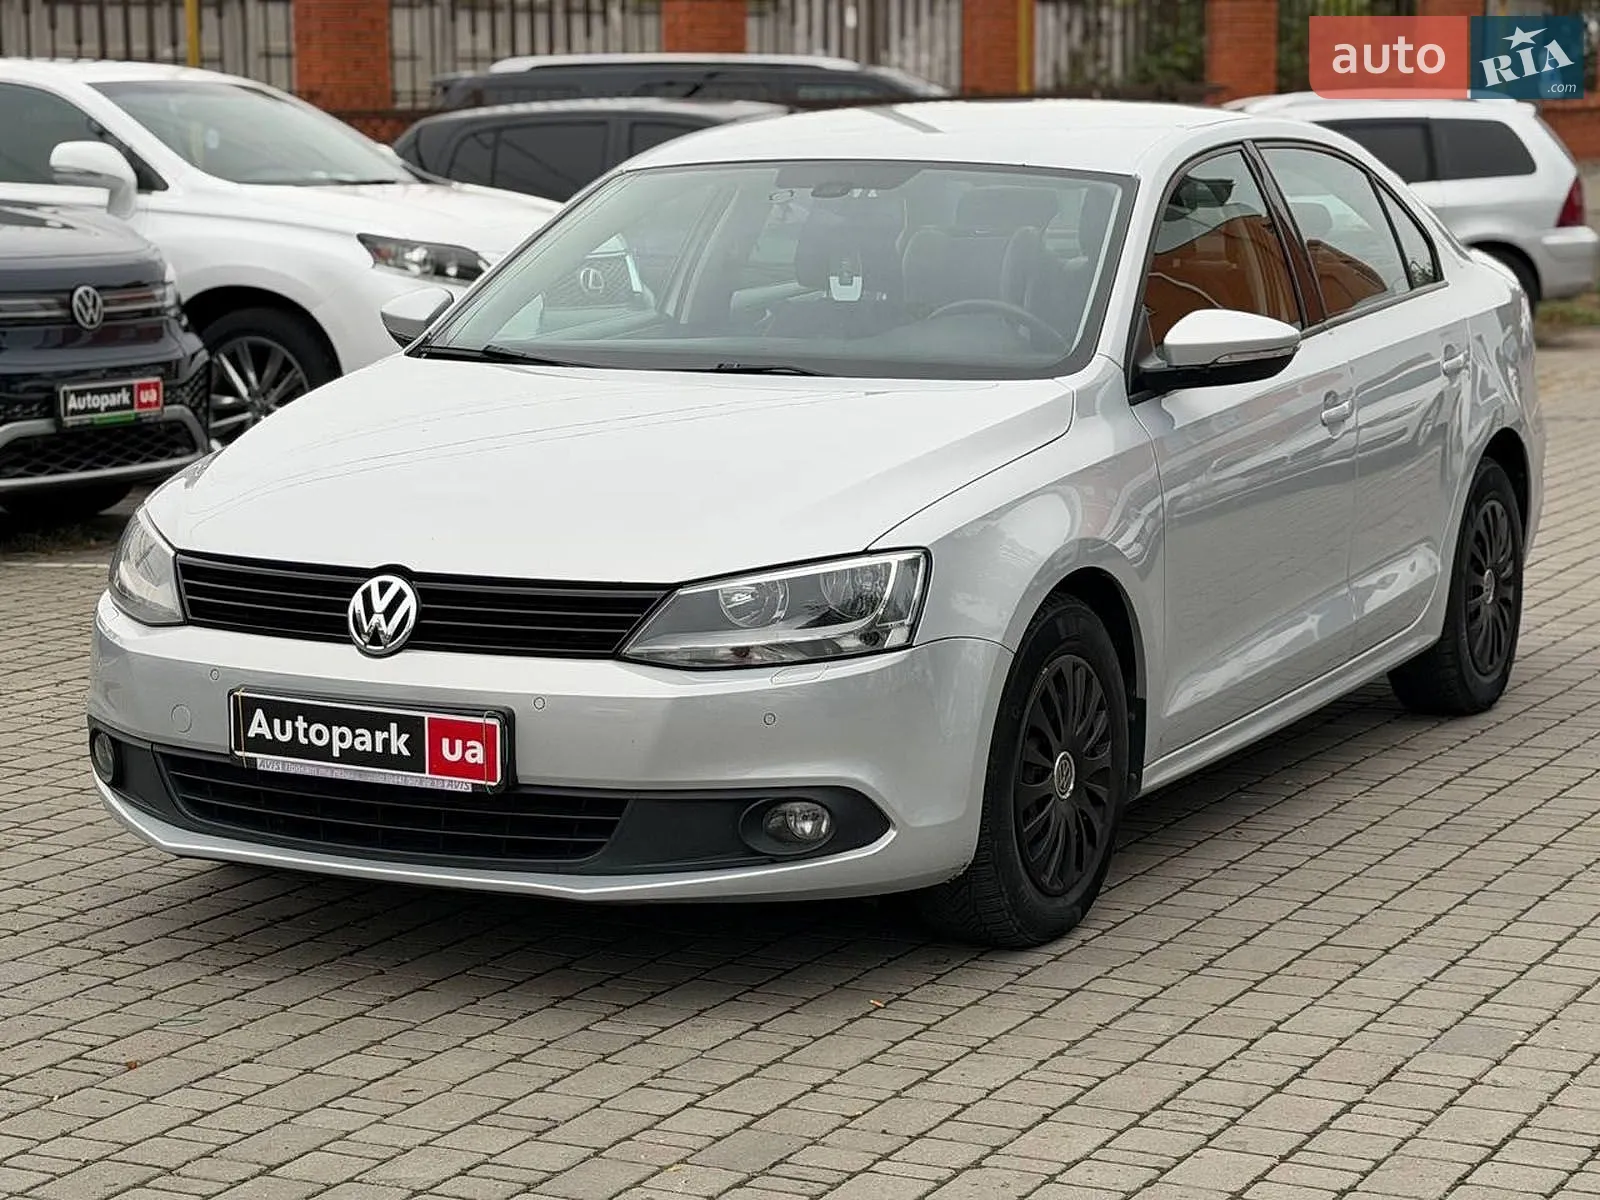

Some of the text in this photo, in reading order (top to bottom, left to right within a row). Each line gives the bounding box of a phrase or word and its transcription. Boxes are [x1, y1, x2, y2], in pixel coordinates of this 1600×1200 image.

[68, 387, 157, 411] Autopark ua
[349, 576, 416, 650] VW
[247, 708, 484, 764] Autopark ua
[258, 758, 471, 791] AVIS AVIS
